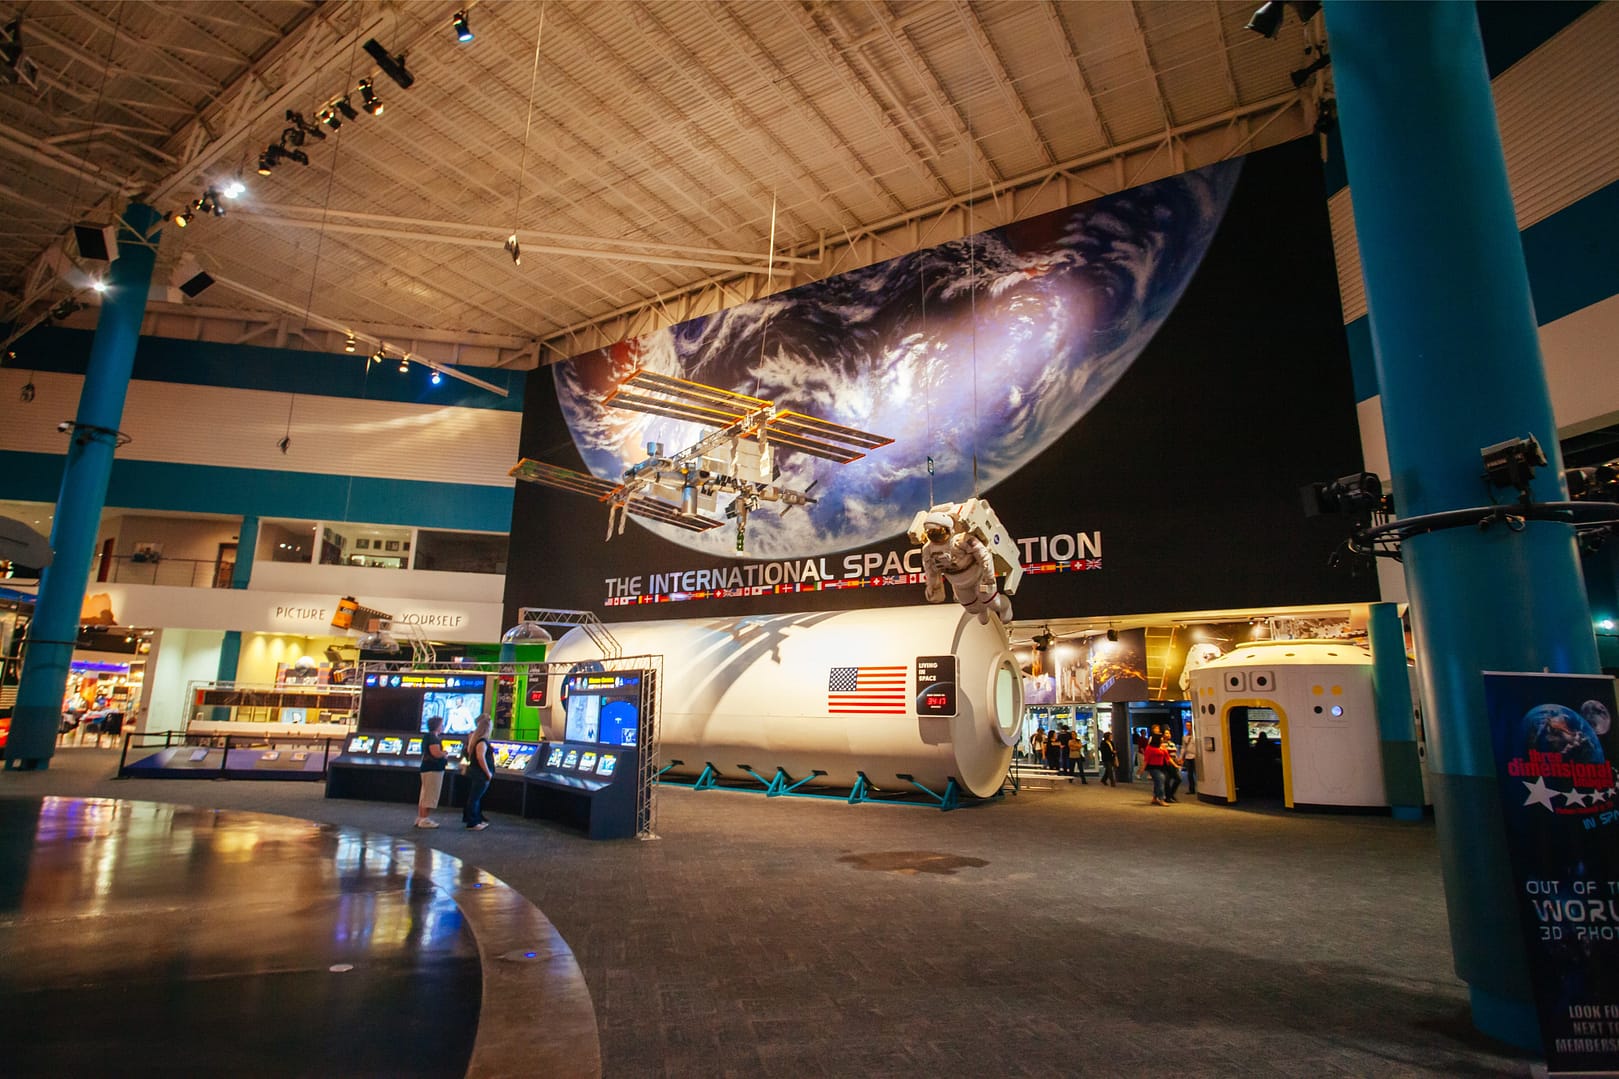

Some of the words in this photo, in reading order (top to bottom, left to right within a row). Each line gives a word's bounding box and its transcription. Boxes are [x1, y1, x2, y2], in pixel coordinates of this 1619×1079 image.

[604, 576, 642, 598] THE
[649, 557, 835, 594] INTERNATIONAL
[843, 549, 923, 579] SPAC
[1017, 530, 1103, 563] TION
[275, 606, 326, 621] PICTURE
[402, 613, 463, 627] YOURSELF
[1525, 880, 1560, 895] OUT
[1572, 880, 1598, 895] OF
[1538, 925, 1562, 941] 3D
[1568, 1004, 1601, 1019] LOOK
[1555, 1038, 1619, 1054] MEMBERS
